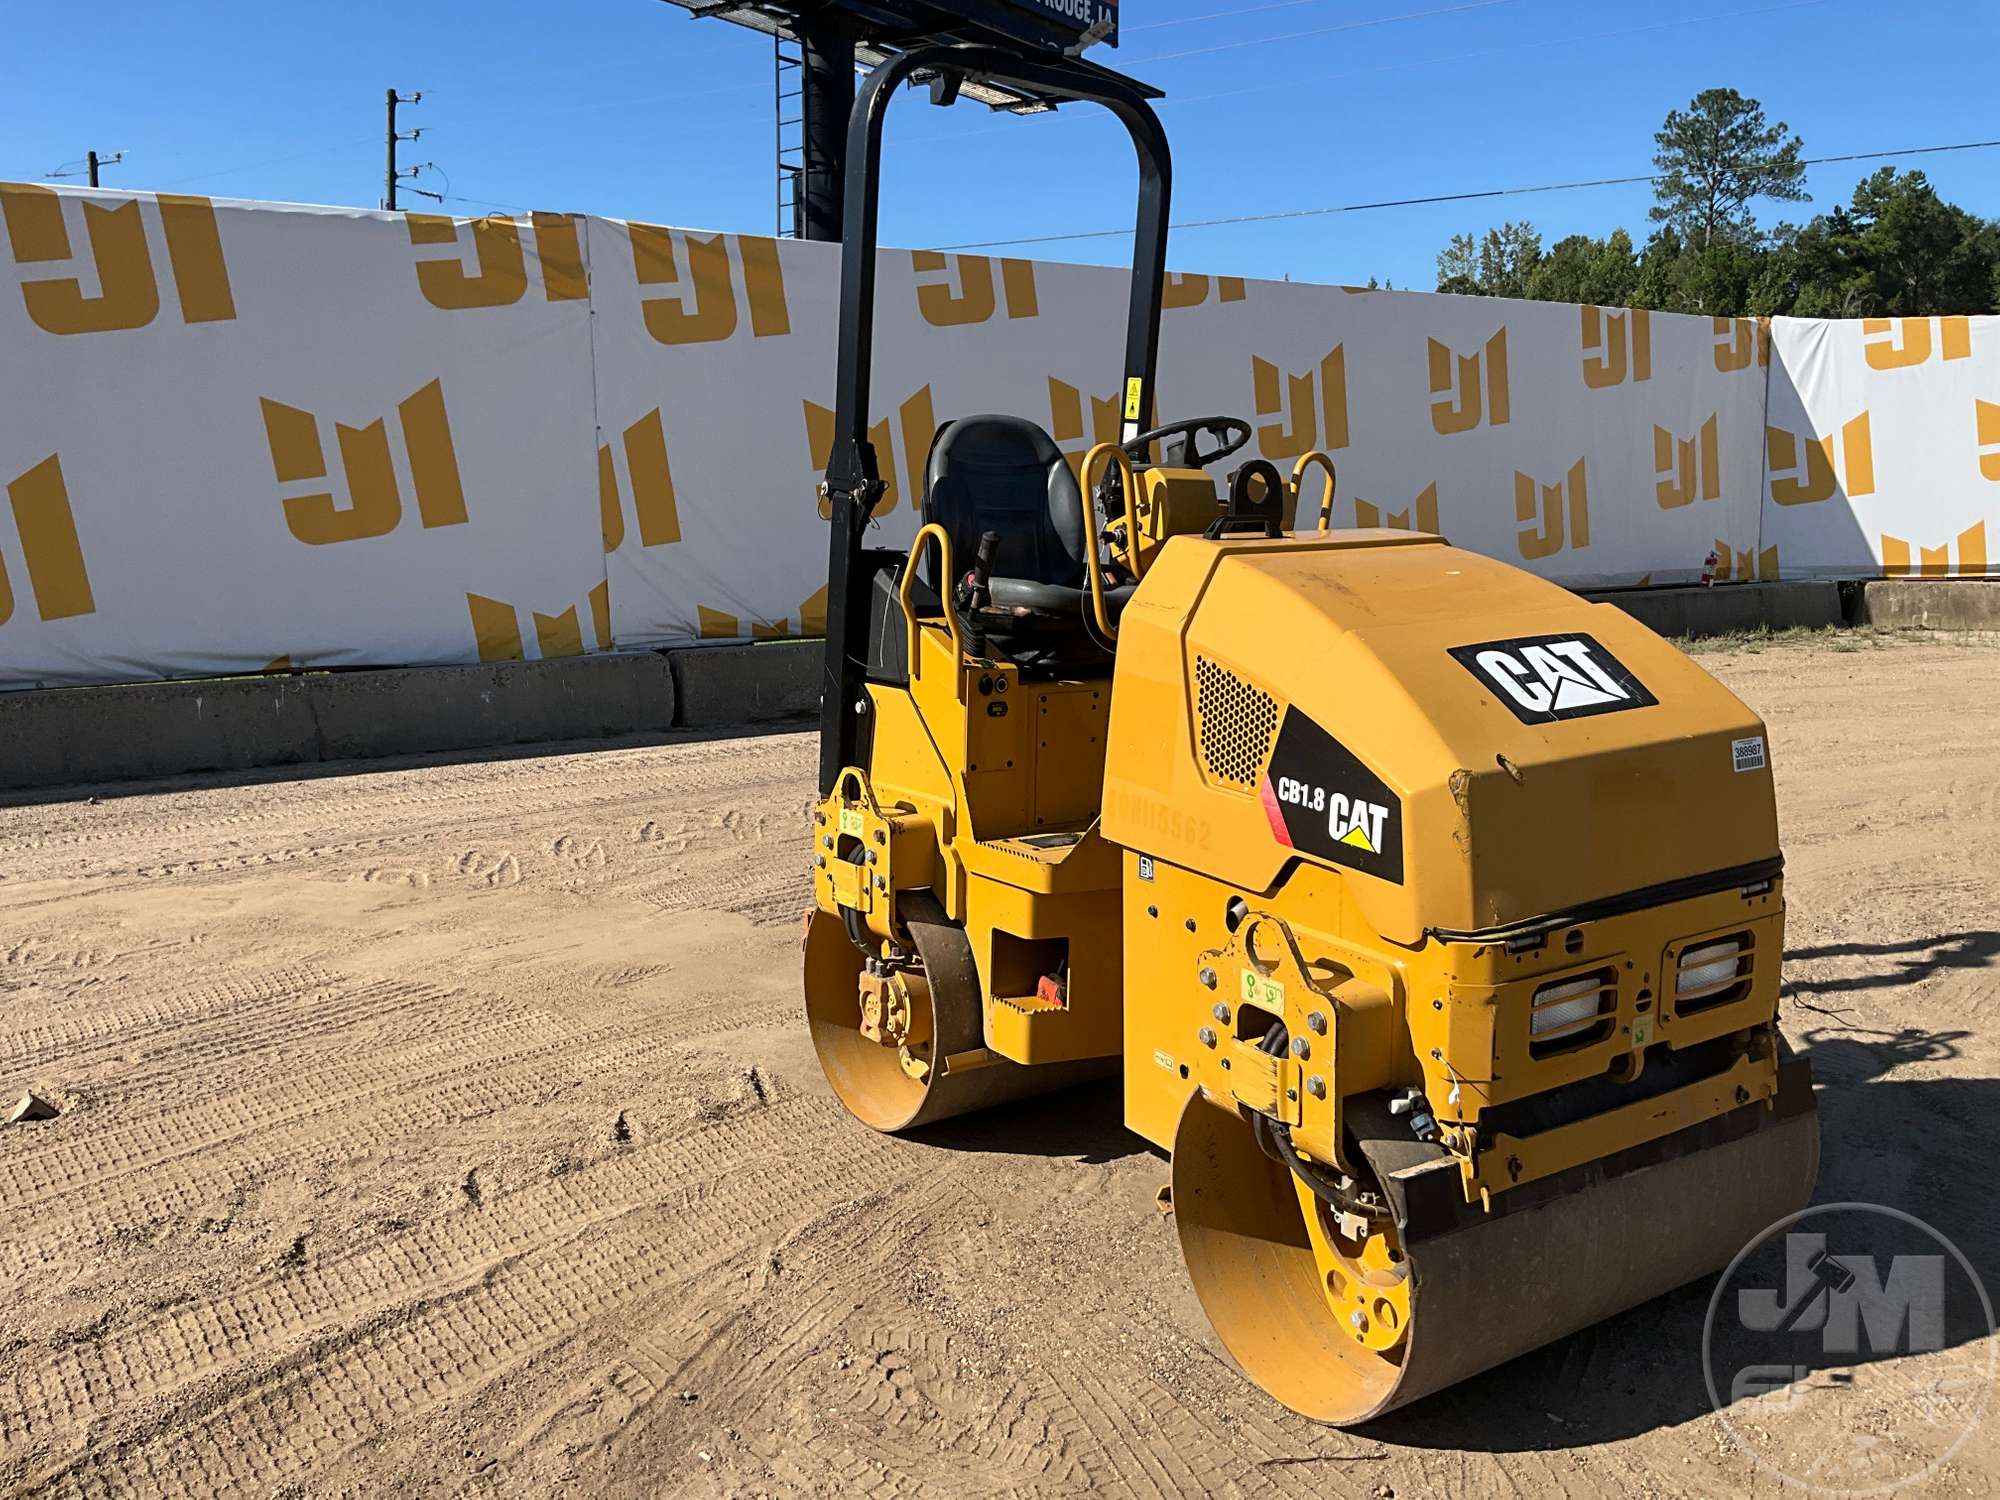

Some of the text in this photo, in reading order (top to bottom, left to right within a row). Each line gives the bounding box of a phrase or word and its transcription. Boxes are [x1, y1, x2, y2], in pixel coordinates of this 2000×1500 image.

[1475, 640, 1631, 713] CAT
[1278, 776, 1325, 812] CB1.8
[1328, 792, 1389, 854] CAT
